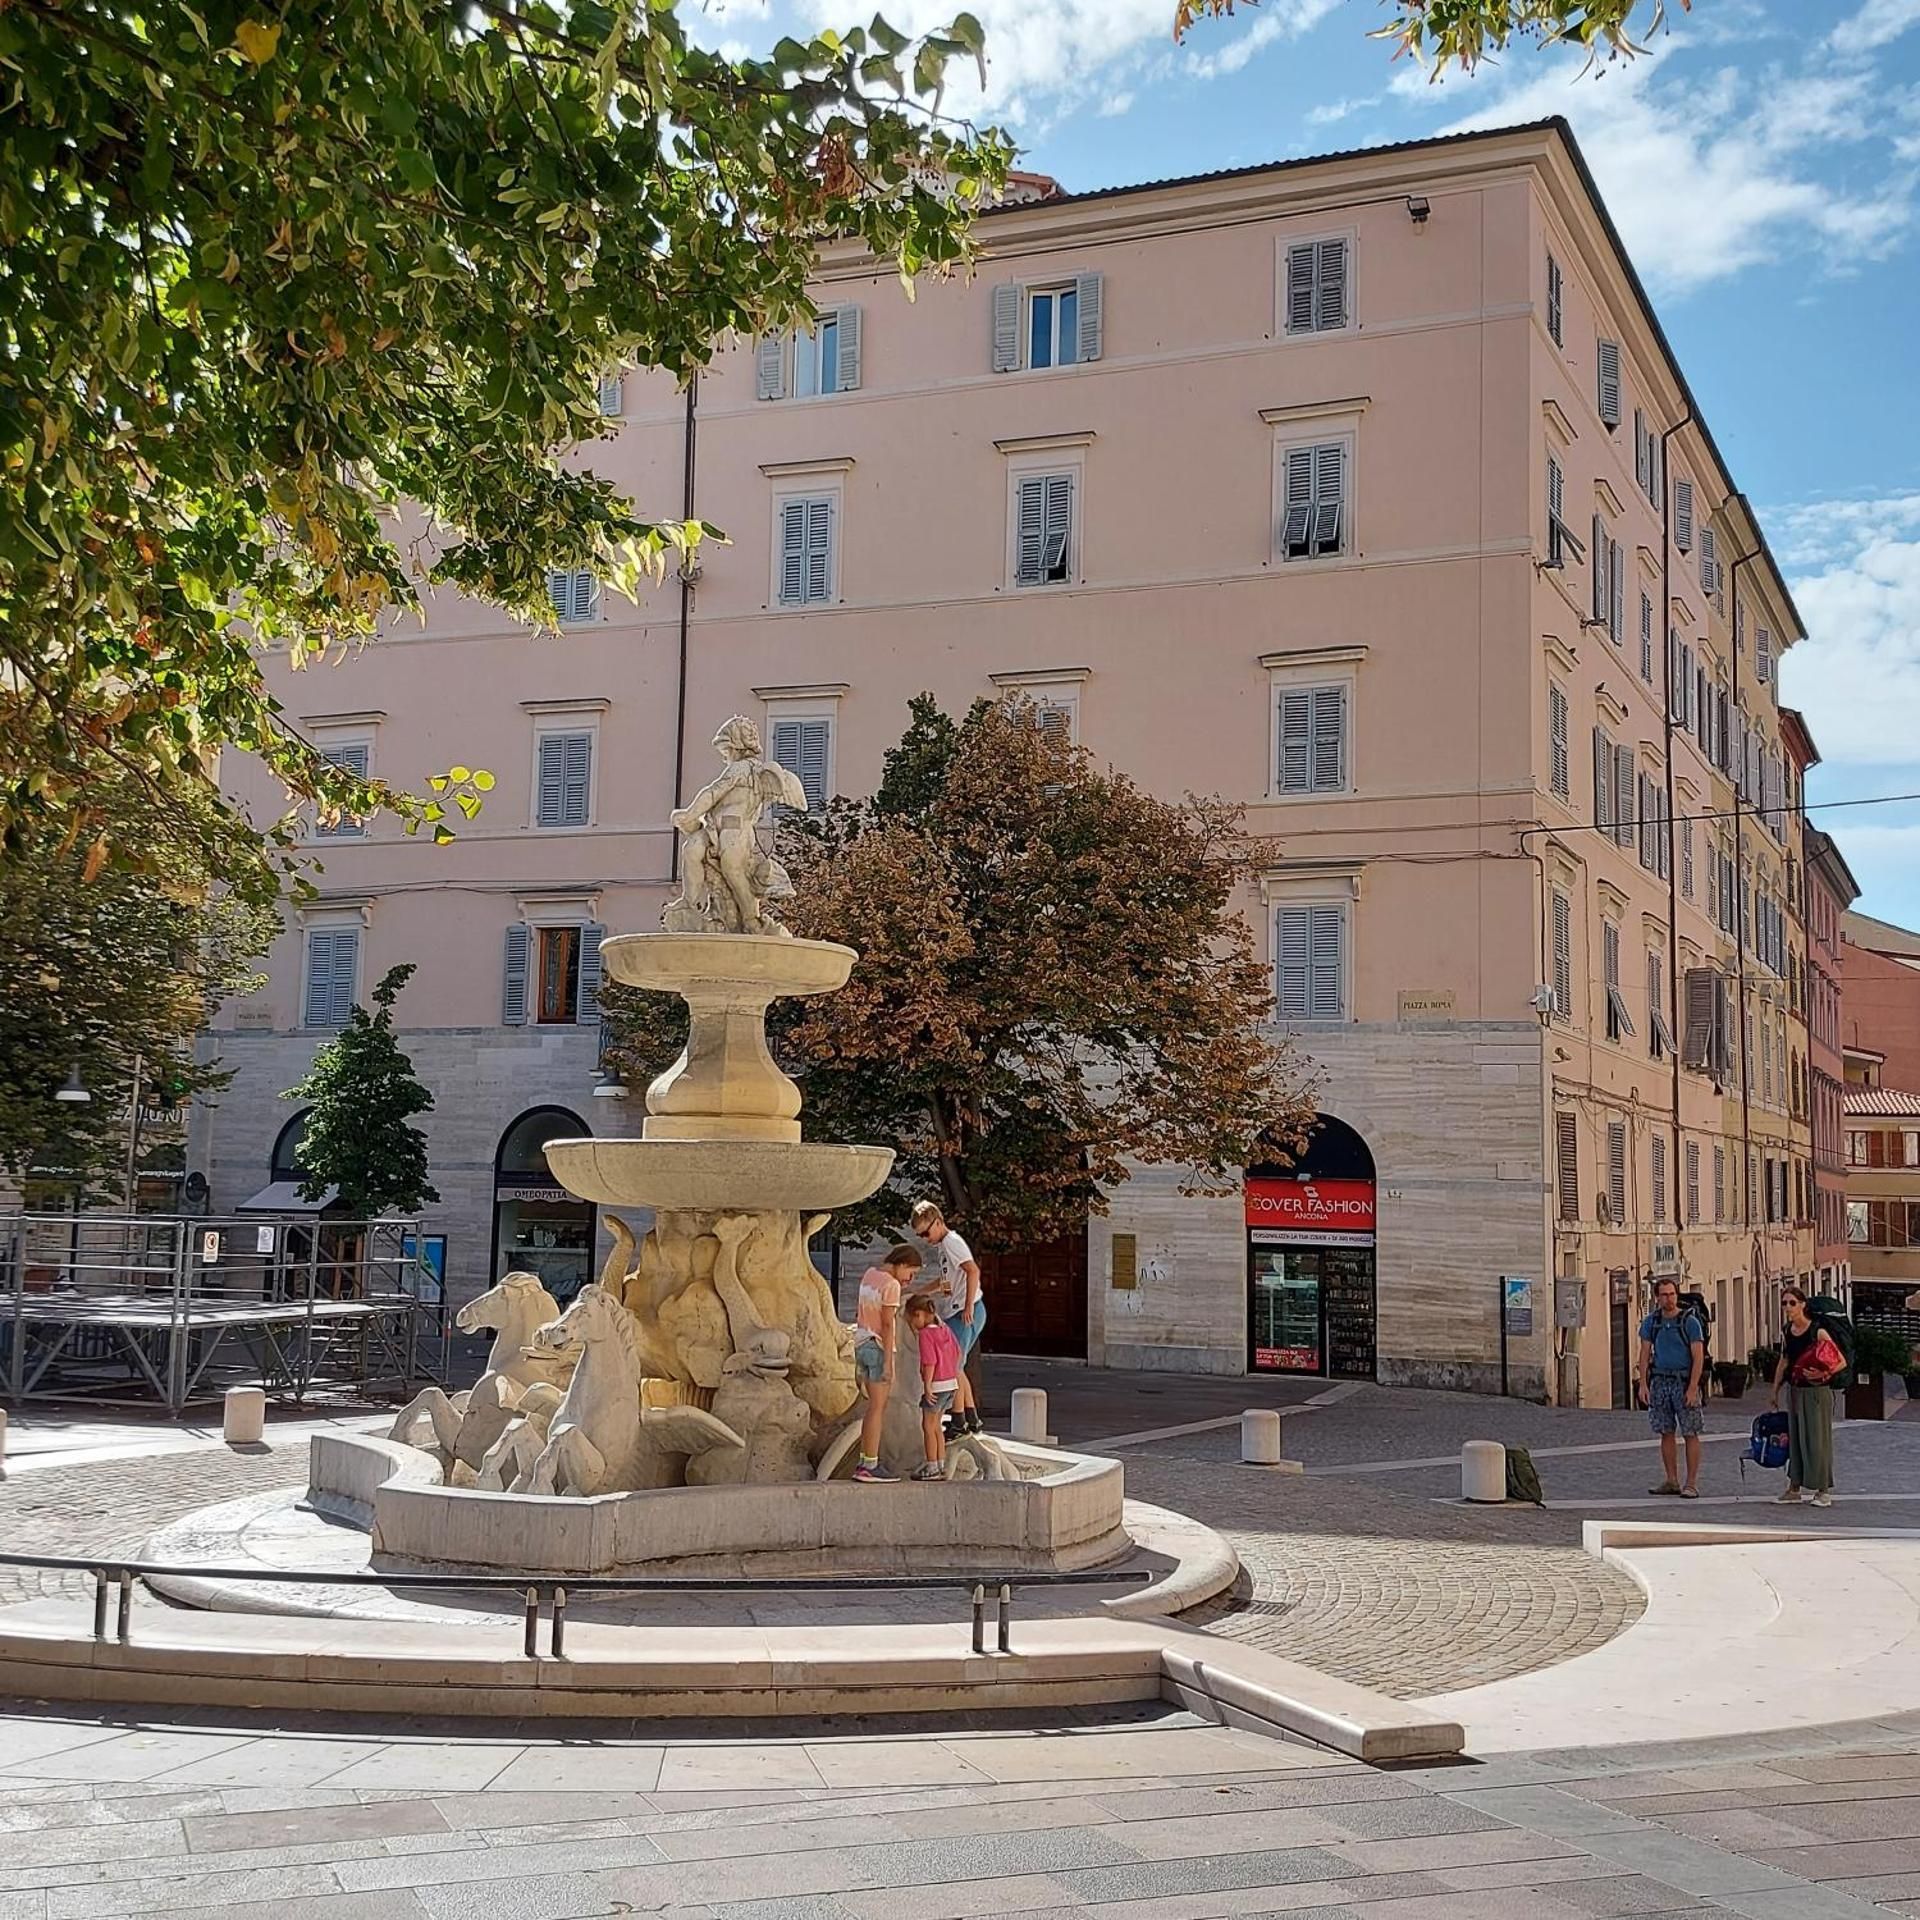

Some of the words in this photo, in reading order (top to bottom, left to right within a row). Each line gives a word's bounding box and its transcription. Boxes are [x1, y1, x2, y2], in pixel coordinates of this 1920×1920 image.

[514, 1190, 568, 1199] OMEOPATIA
[1252, 1198, 1304, 1212] COVER
[1307, 1199, 1373, 1215] FASHION
[1294, 1212, 1329, 1220] ANCONA
